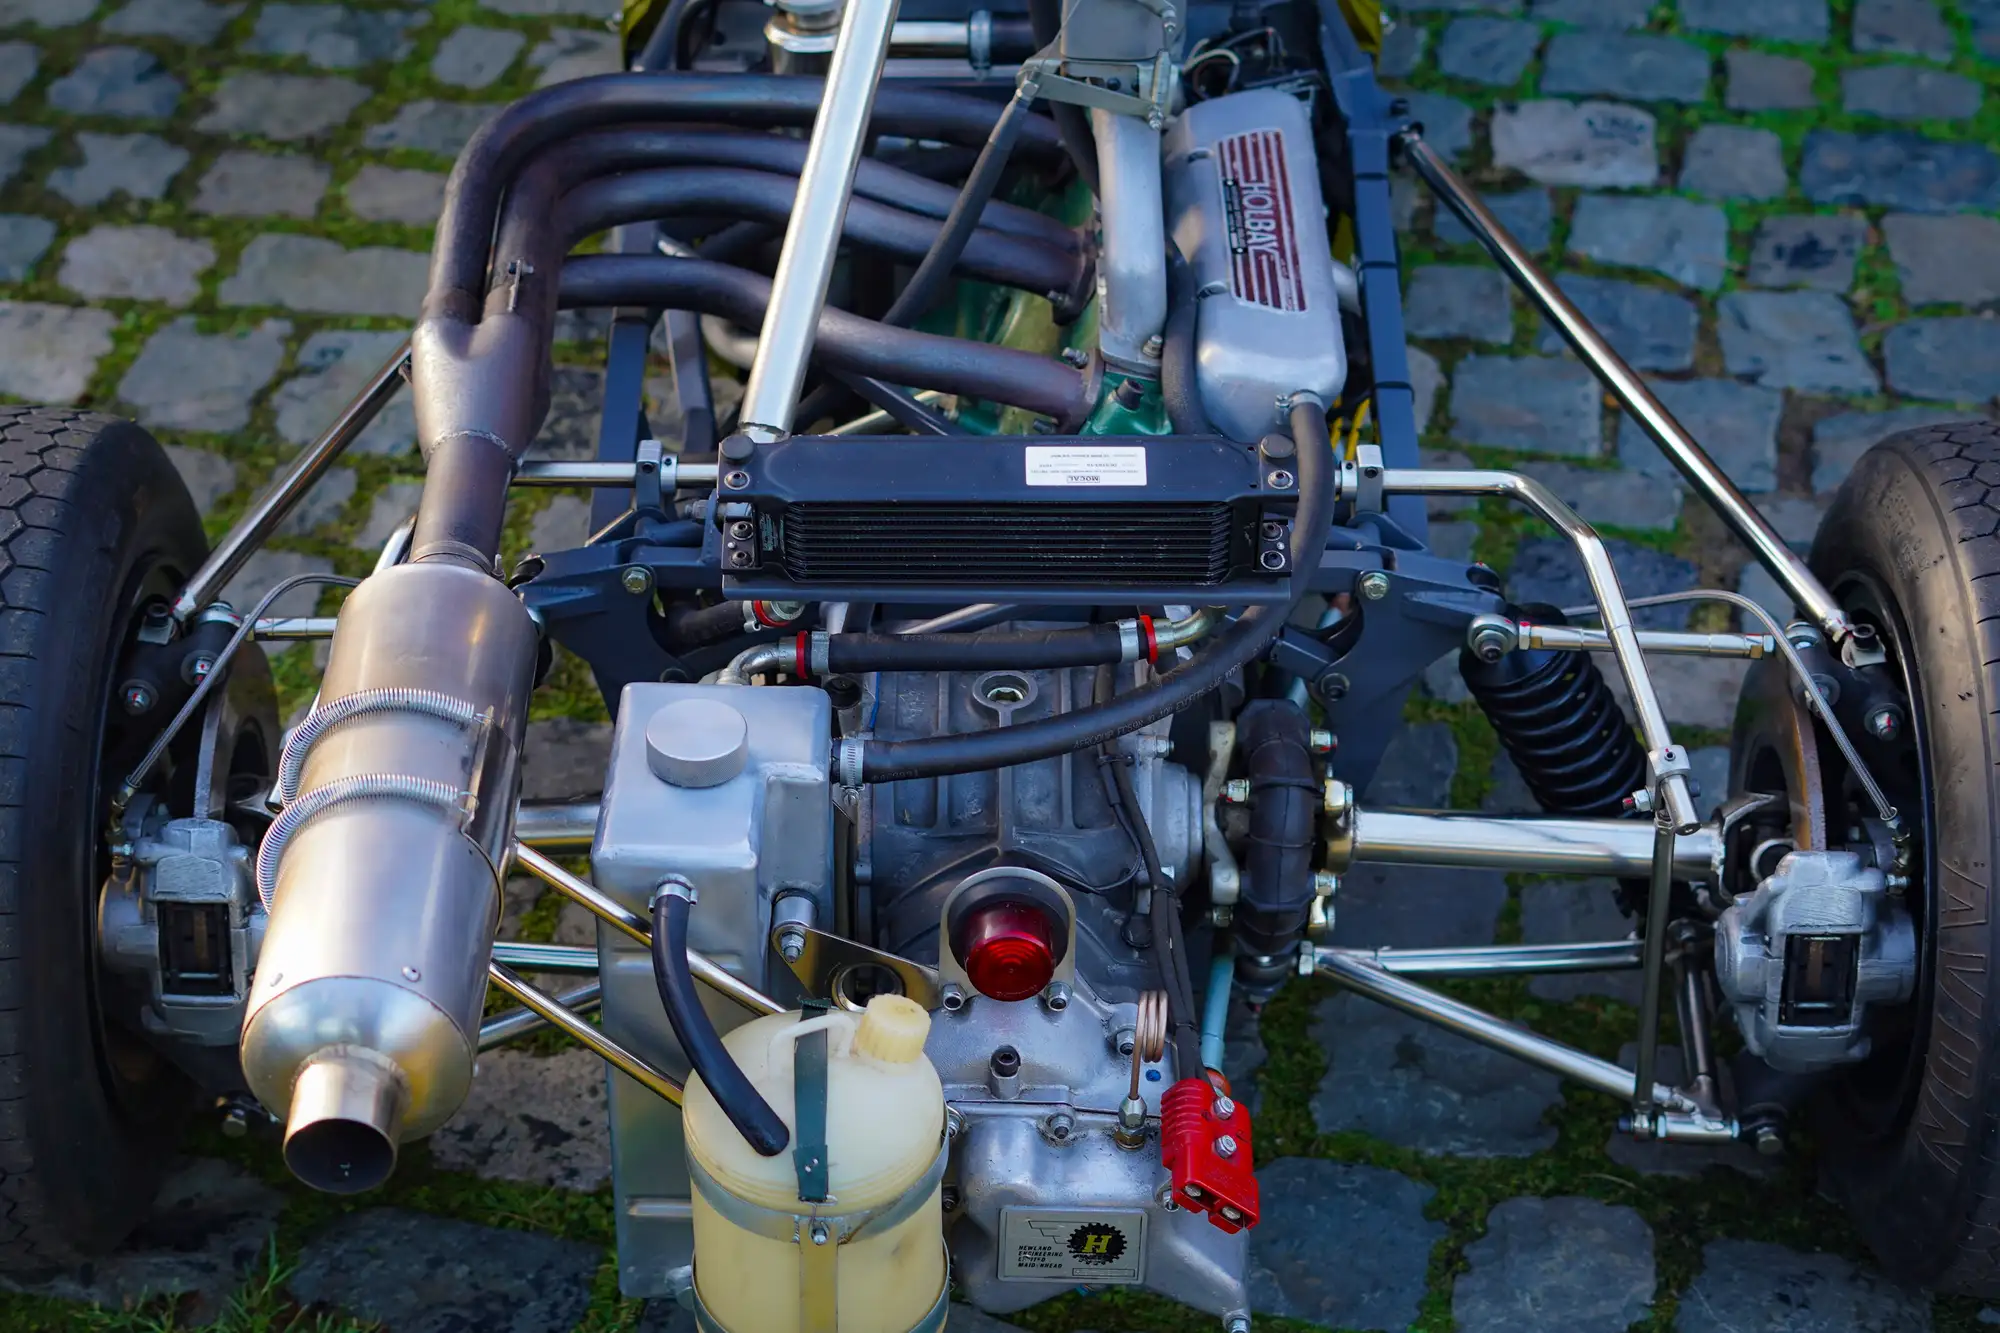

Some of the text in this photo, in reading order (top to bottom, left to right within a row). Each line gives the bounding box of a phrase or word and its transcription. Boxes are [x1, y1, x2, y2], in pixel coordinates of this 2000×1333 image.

[1241, 180, 1280, 255] HOLBAY
[1915, 857, 1991, 1176] AVON
[1082, 1234, 1112, 1253] H
